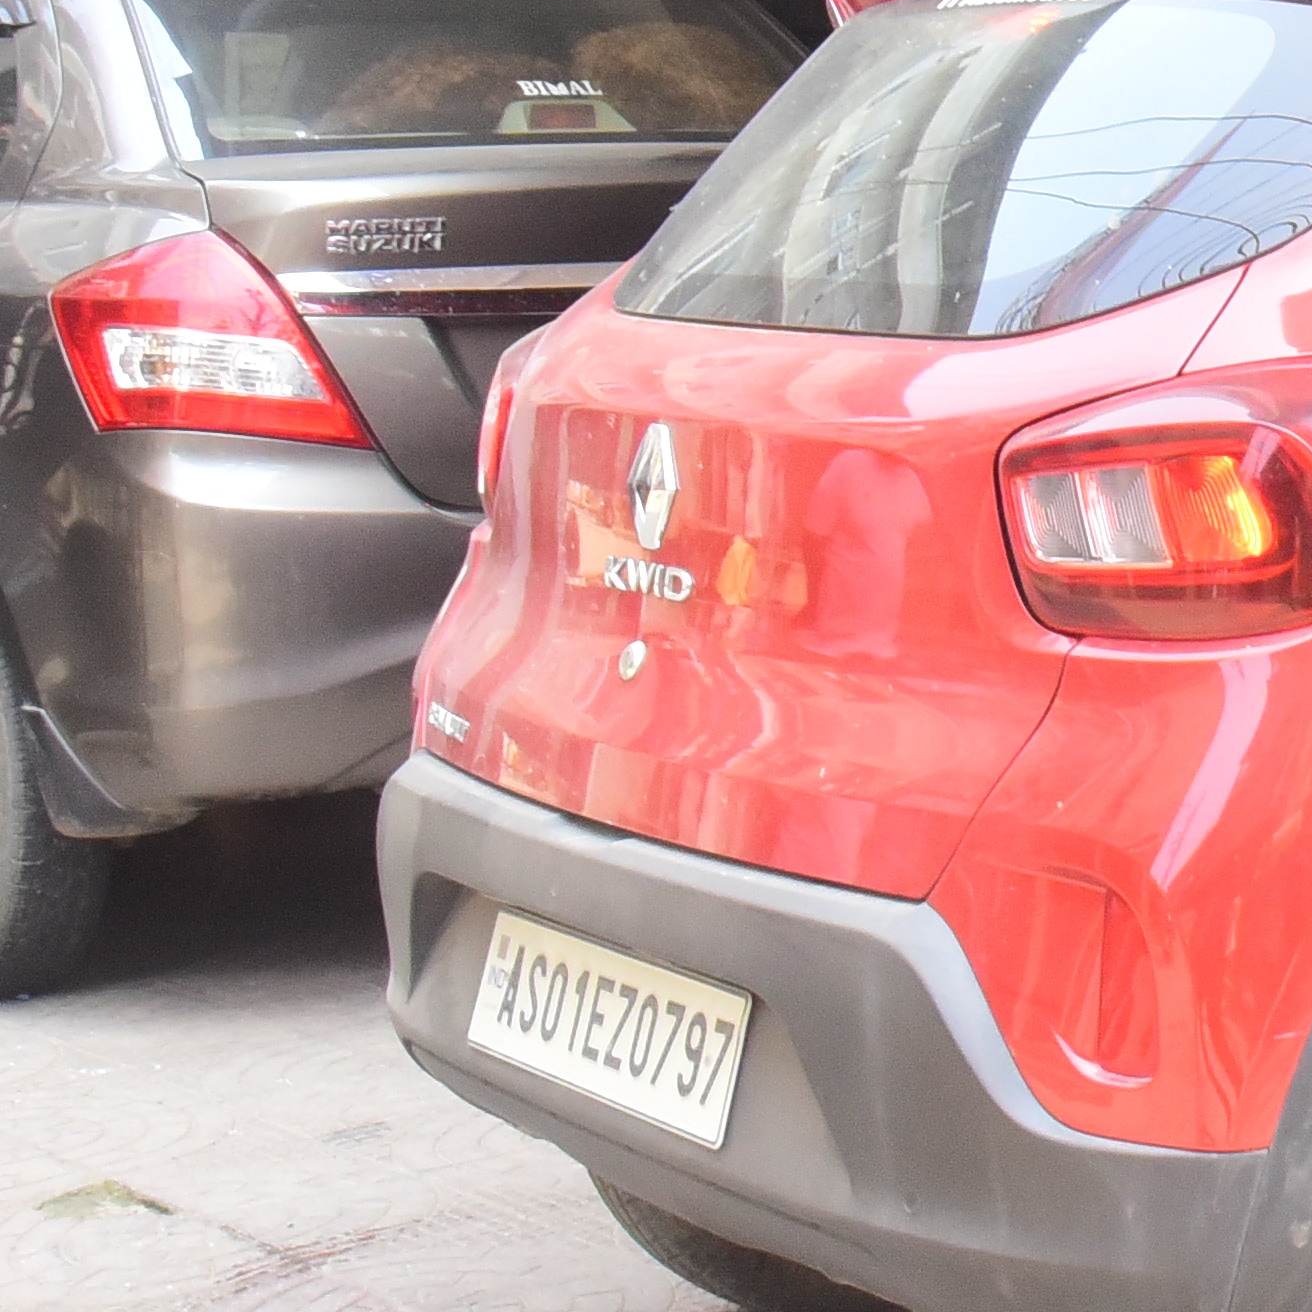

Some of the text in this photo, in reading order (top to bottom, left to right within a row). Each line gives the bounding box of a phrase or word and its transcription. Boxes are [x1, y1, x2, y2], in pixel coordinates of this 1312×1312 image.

[516, 79, 604, 96] BIMAL
[325, 215, 447, 234] MARUTI
[325, 233, 447, 255] SUZUKI
[604, 554, 696, 602] KWID
[497, 944, 736, 1107] AS01EZ0797
